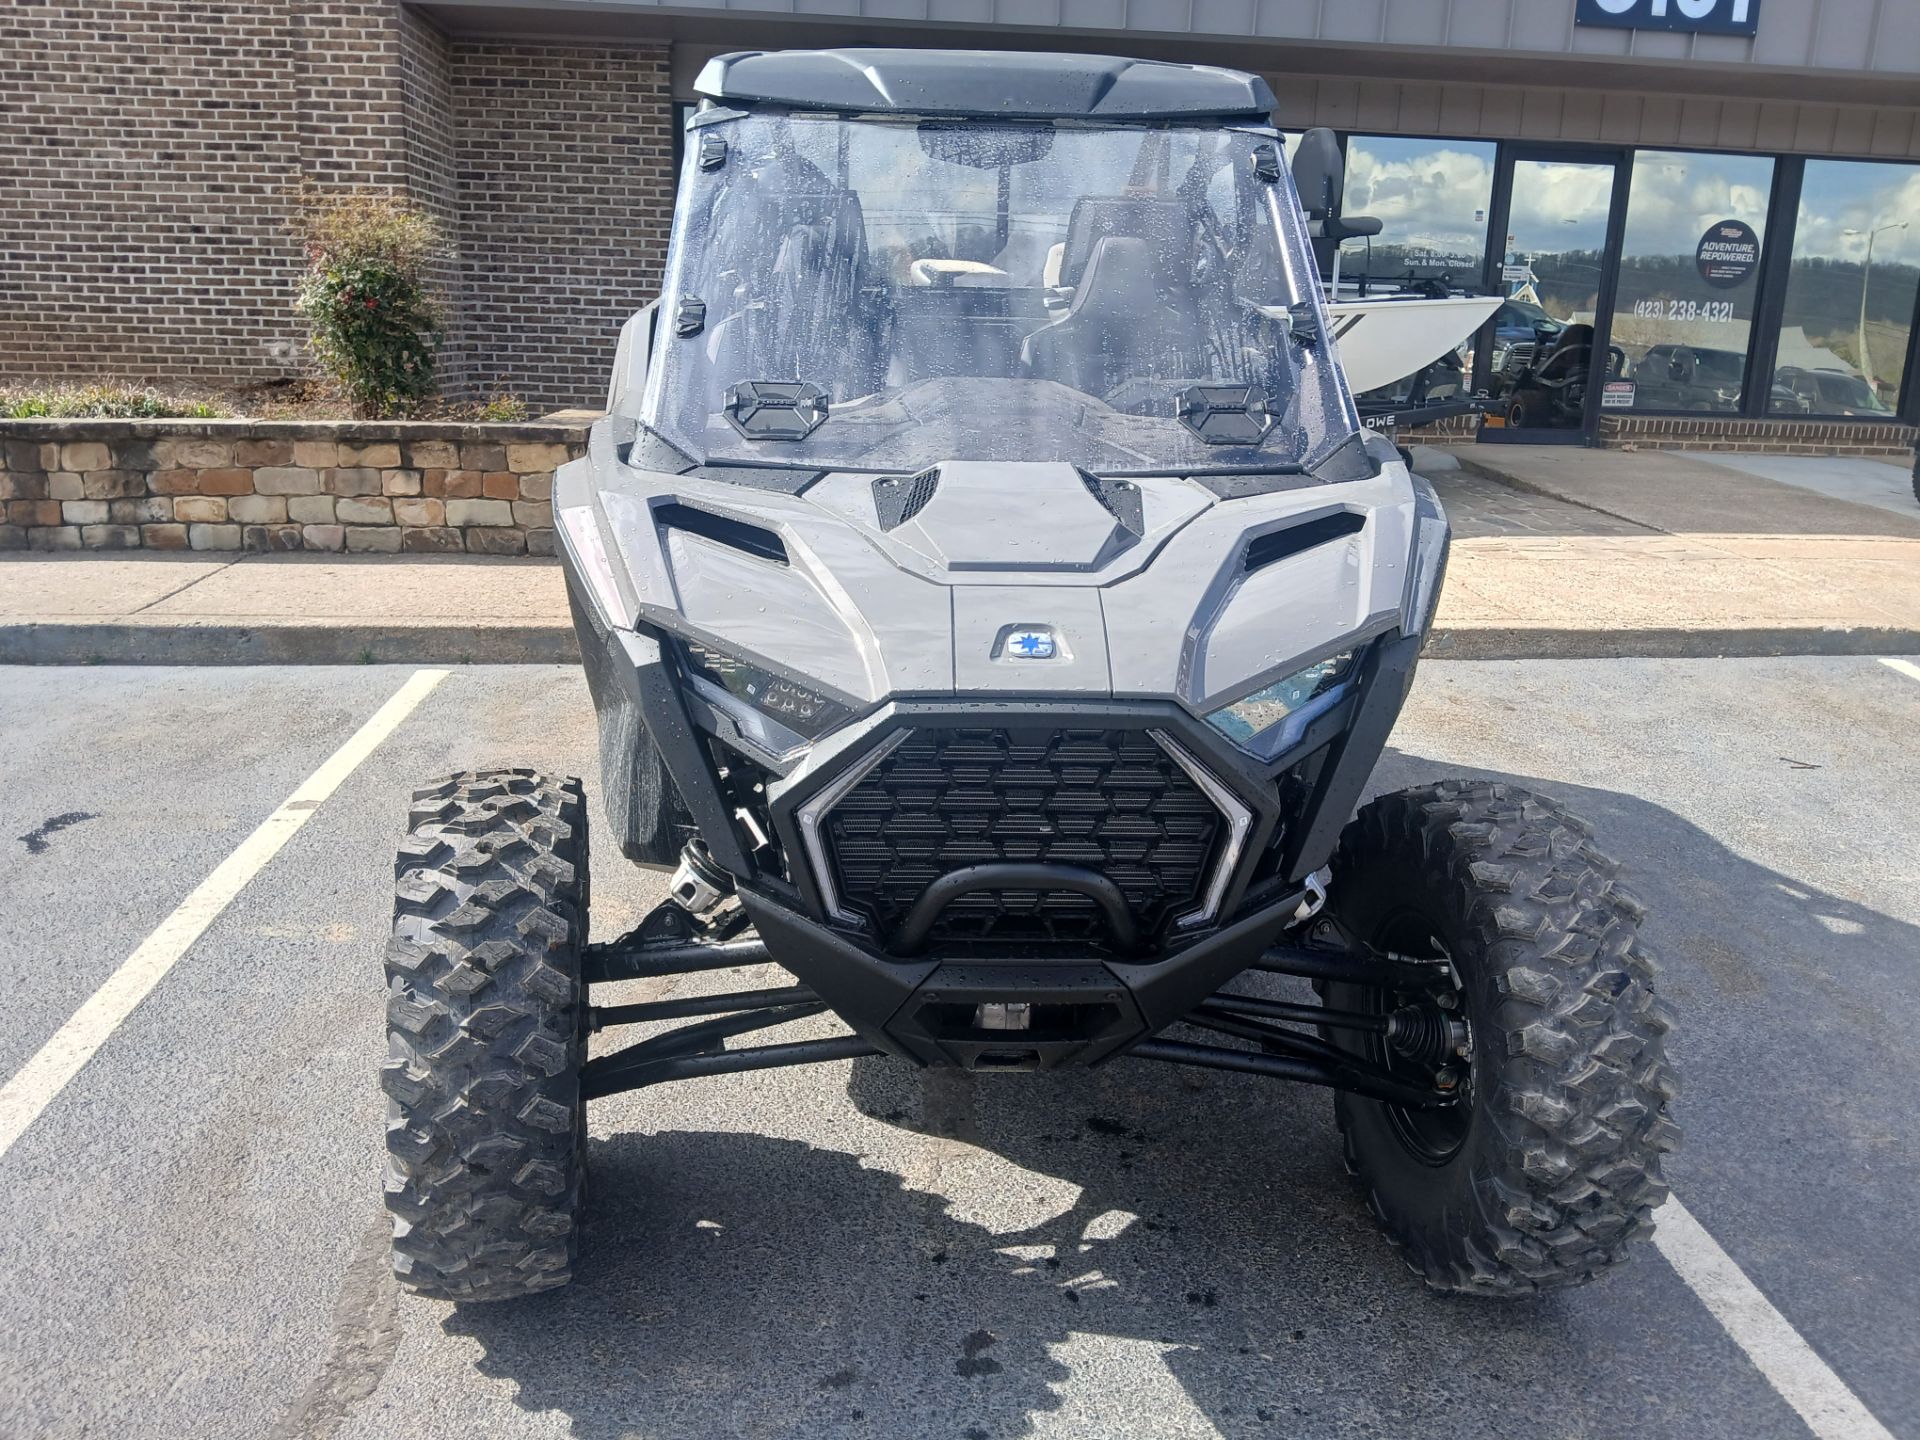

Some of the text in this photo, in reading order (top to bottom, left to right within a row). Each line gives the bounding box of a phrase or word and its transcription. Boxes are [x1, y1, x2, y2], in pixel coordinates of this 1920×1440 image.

[1702, 242, 1755, 253] ADVENTURE,
[1700, 251, 1754, 262] REPOWERED.
[1404, 258, 1420, 266] Sun.
[1429, 259, 1447, 267] Mon.
[1448, 260, 1475, 268] Closed
[1633, 299, 1735, 323] (423) 238-4321
[1366, 415, 1395, 428] OWE
